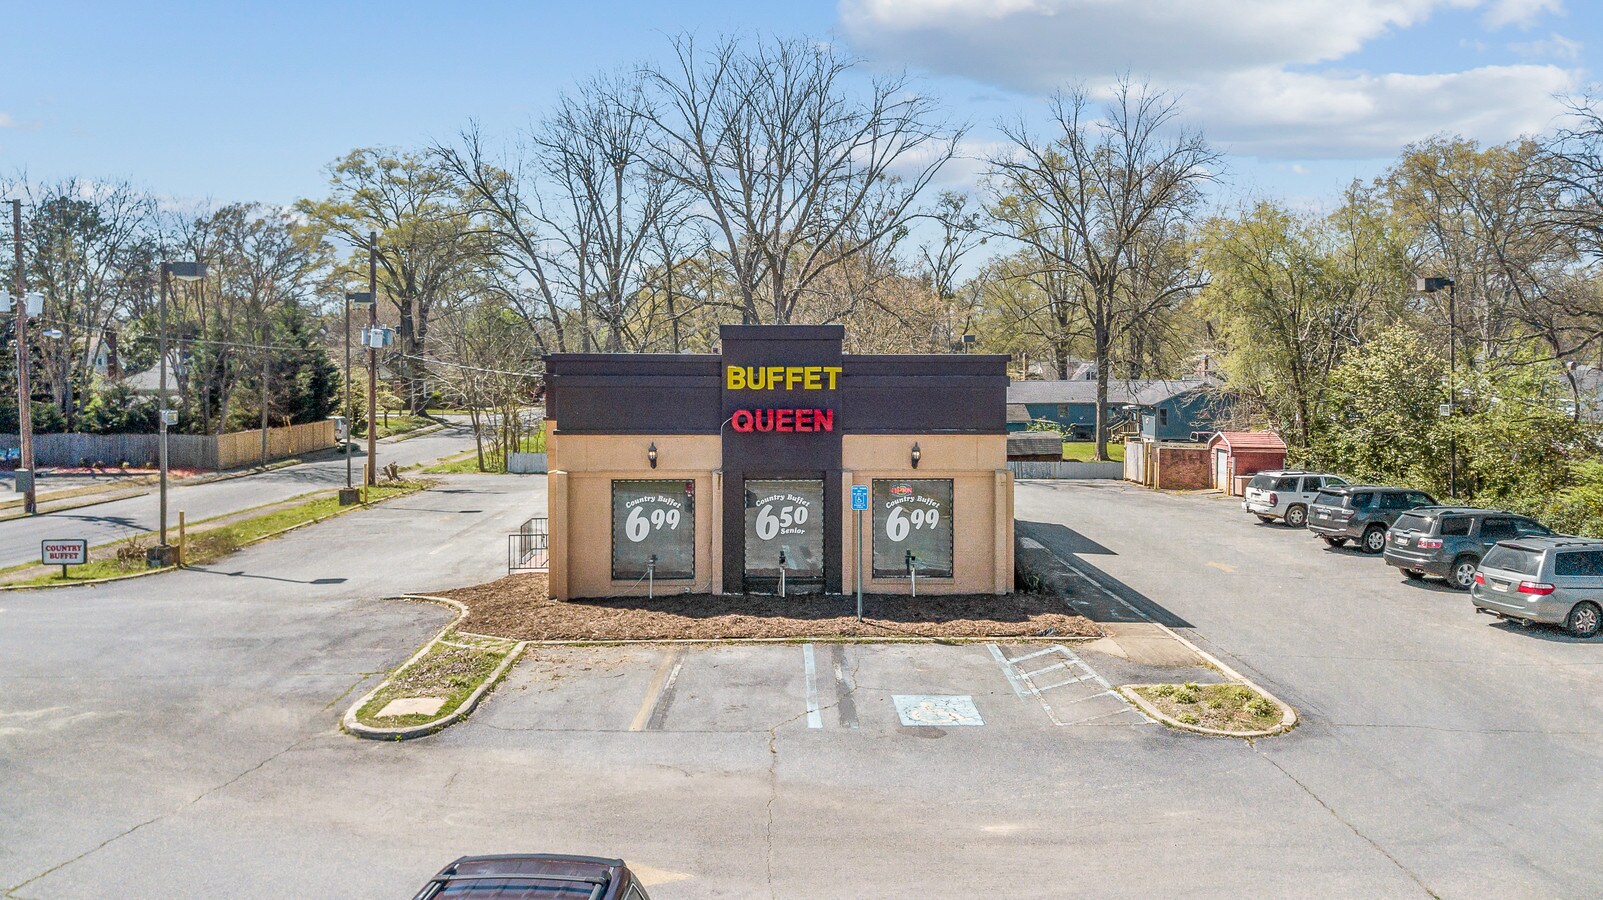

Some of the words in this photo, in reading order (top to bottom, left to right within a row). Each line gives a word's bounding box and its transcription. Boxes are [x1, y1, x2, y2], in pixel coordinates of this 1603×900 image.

[727, 365, 843, 390] BUFFET
[731, 408, 834, 433] QUEEN
[625, 495, 656, 509] Country
[657, 495, 682, 509] Buffet
[755, 494, 785, 507] Country
[787, 493, 811, 507] Buffet
[885, 495, 915, 509] Country
[916, 495, 940, 508] Buffet
[780, 526, 806, 535] Senior
